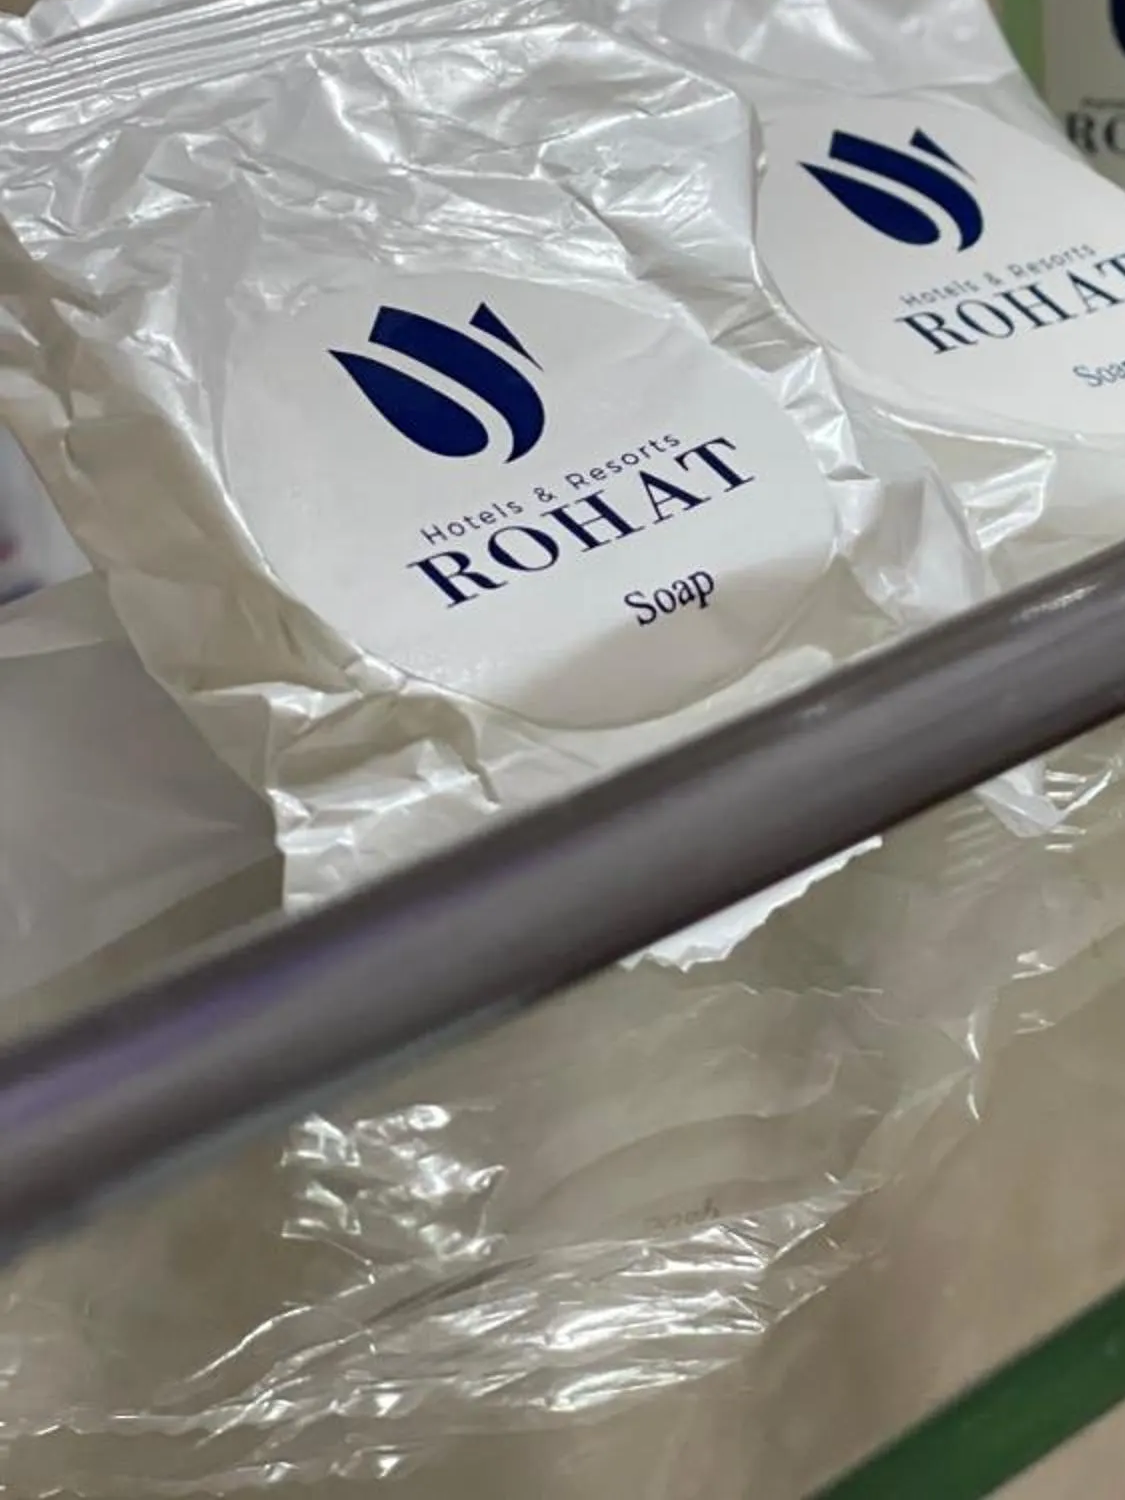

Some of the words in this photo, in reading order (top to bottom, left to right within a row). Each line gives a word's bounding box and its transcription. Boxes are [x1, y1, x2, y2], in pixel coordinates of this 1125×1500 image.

[899, 279, 979, 308] Hotels
[983, 271, 1004, 287] &
[1007, 243, 1098, 278] Resorts
[405, 435, 756, 609] ROHAT
[420, 498, 524, 546] Hotels
[533, 486, 558, 504] &
[564, 432, 681, 491] Resorts
[623, 569, 715, 627] Soap
